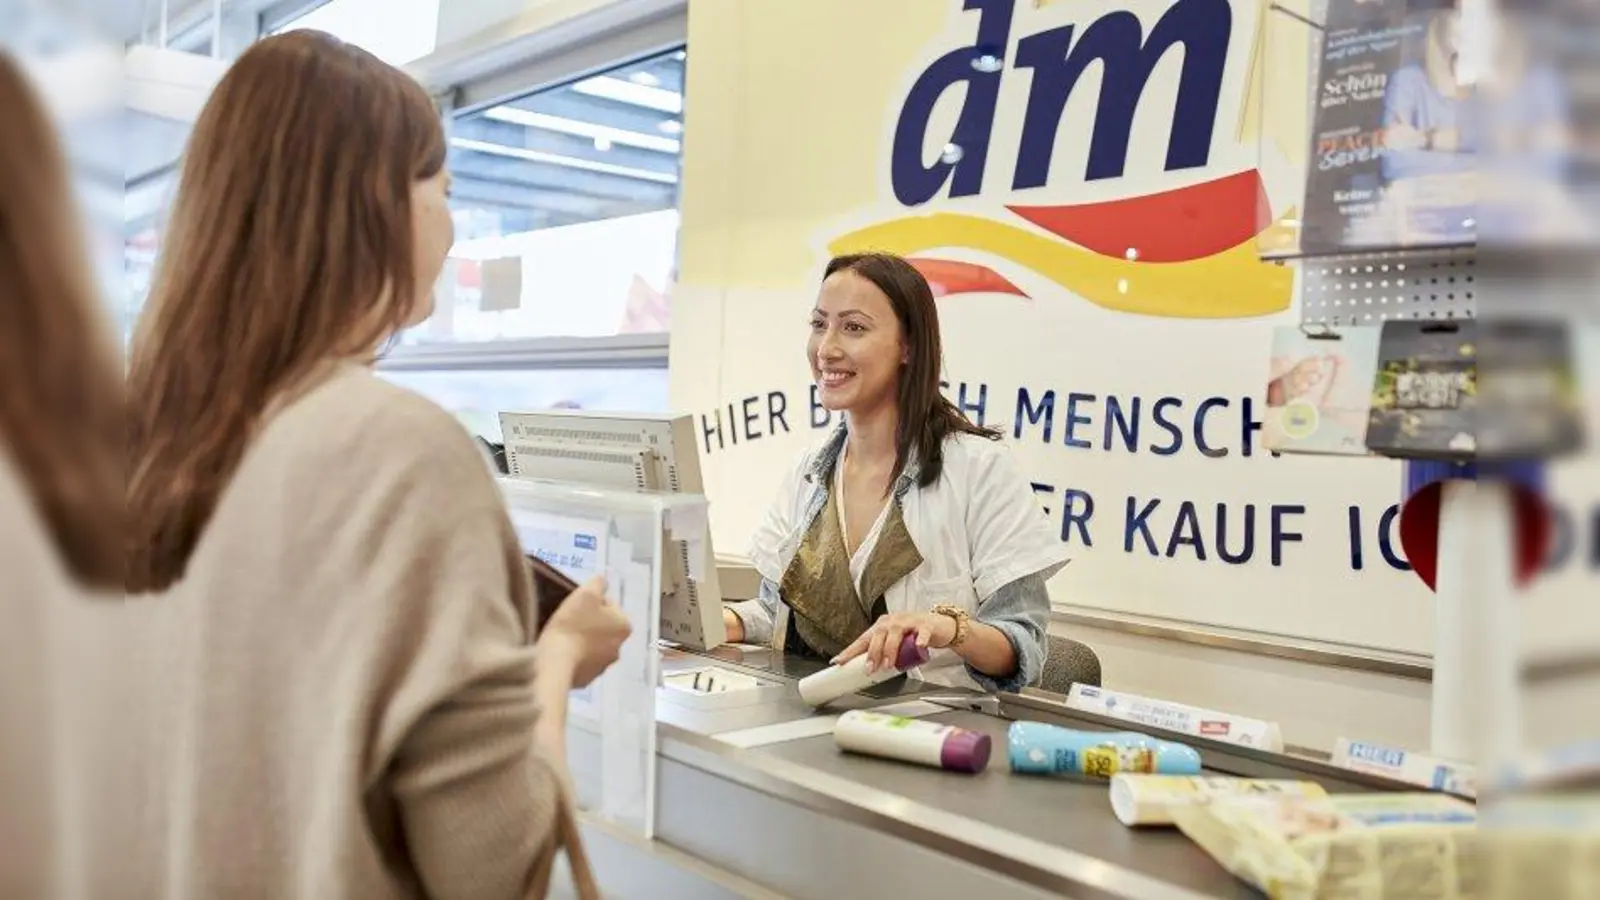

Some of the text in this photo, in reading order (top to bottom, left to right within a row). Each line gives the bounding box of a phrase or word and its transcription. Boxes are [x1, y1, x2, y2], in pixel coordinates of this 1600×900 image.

[891, 0, 1232, 207] dm
[1325, 73, 1387, 95] Schön
[701, 391, 789, 453] HIER
[1124, 496, 1305, 566] KAUF
